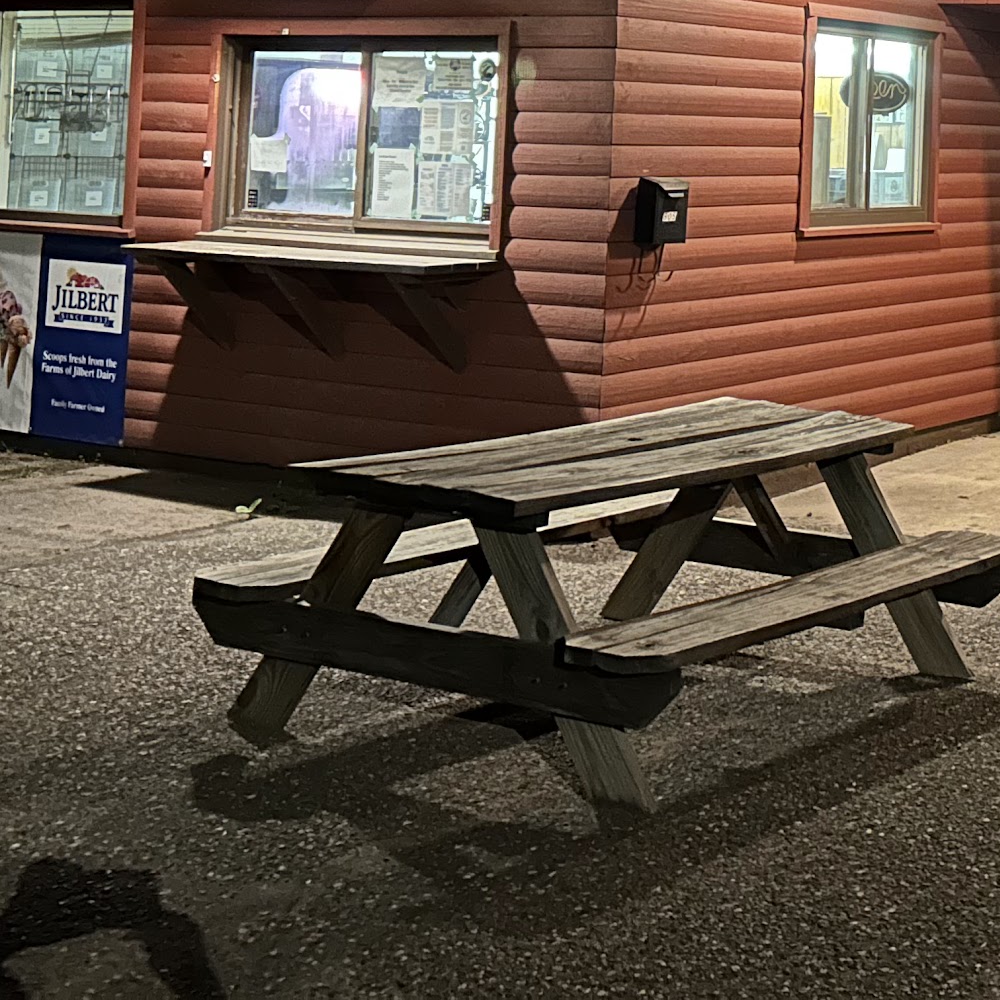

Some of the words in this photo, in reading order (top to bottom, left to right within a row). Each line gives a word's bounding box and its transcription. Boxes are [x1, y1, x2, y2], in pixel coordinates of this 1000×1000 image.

[52, 285, 119, 313] JILBERT
[60, 312, 84, 321] SINCE
[43, 350, 67, 364] Scoops
[69, 353, 86, 365] fresh
[88, 355, 104, 367] from
[106, 358, 117, 368] the
[41, 362, 64, 374] Farms
[65, 365, 72, 375] of
[72, 366, 95, 378] Jilbert
[96, 368, 117, 383] Dairy
[68, 400, 86, 411] Farmer
